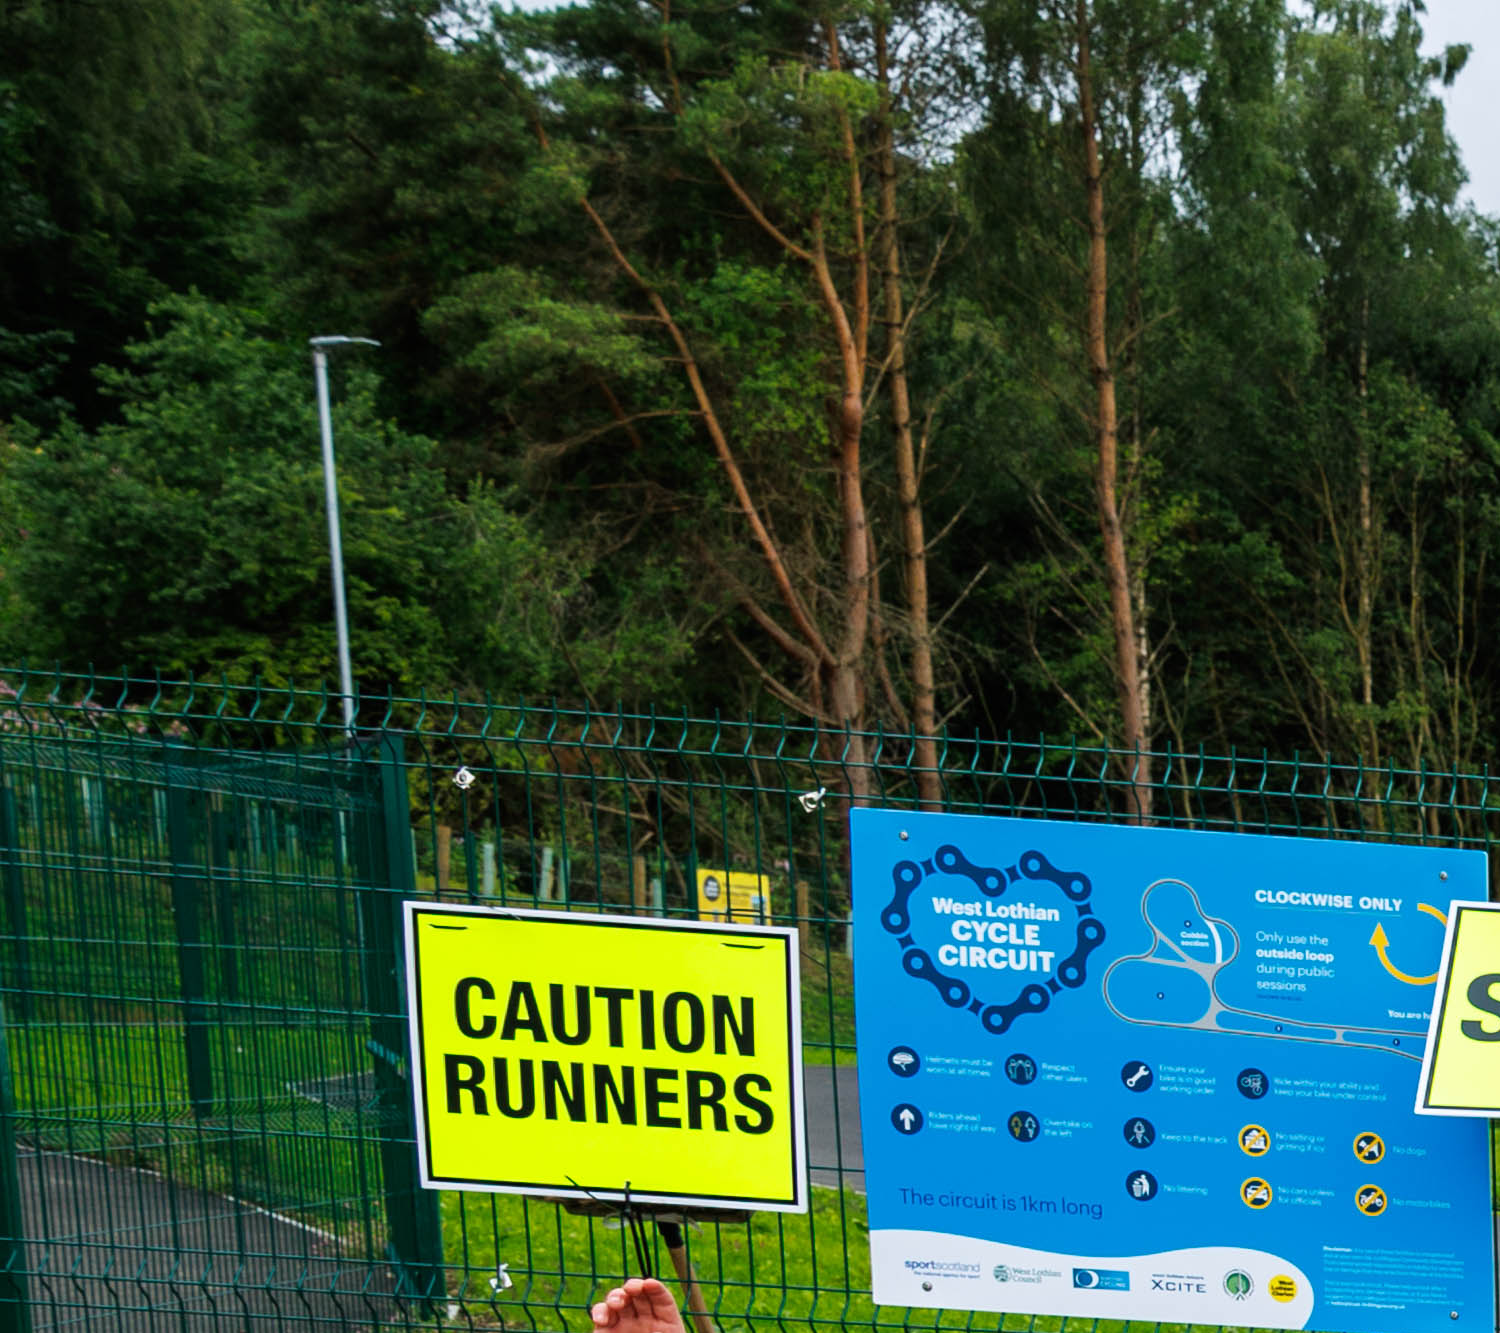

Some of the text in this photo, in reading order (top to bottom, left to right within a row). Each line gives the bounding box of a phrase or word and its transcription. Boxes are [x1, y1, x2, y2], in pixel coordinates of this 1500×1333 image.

[932, 897, 1061, 922] West Lothian
[1255, 889, 1402, 912] CLOCKWISE ONLY
[951, 919, 1041, 946] CYCLE
[1256, 931, 1329, 946] Only use the
[938, 944, 1056, 973] CIRCUIT
[1256, 948, 1335, 963] outside loop
[1256, 962, 1335, 979] during public
[1257, 980, 1307, 992] sessions
[455, 977, 755, 1057] CAUTION
[1388, 1009, 1405, 1019] You
[444, 1053, 774, 1134] RUNNERS
[899, 1187, 1103, 1220] The circuit is 1km long
[904, 1259, 981, 1273] sportscotland
[1152, 1279, 1207, 1294] XCITE
